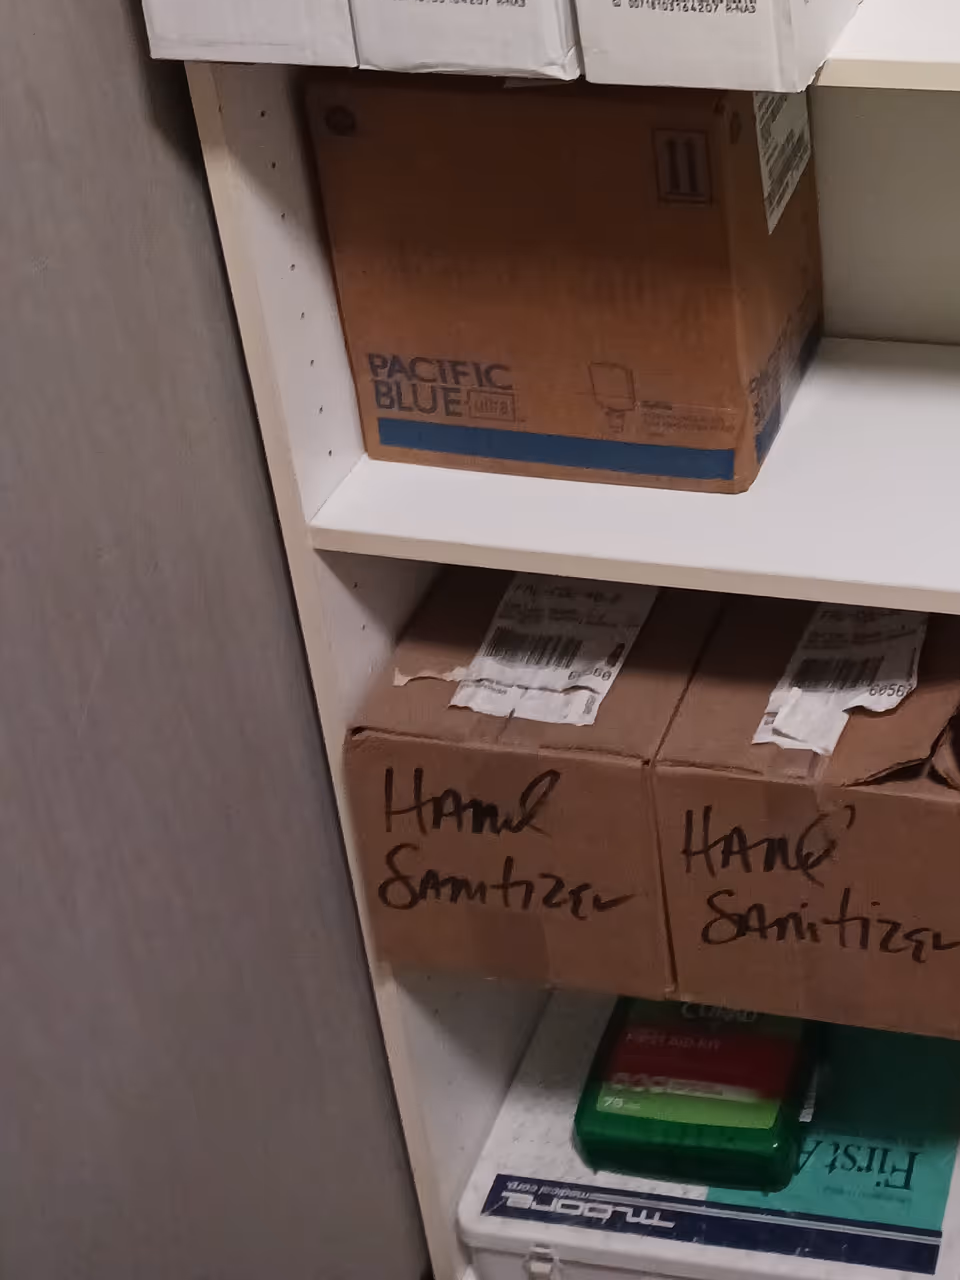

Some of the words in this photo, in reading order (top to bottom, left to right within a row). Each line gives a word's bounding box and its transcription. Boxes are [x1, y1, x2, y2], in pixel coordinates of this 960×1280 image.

[367, 352, 514, 390] PACIFIC
[373, 380, 464, 418] BLUE
[827, 1146, 921, 1191] First
[540, 1184, 591, 1199] medical
